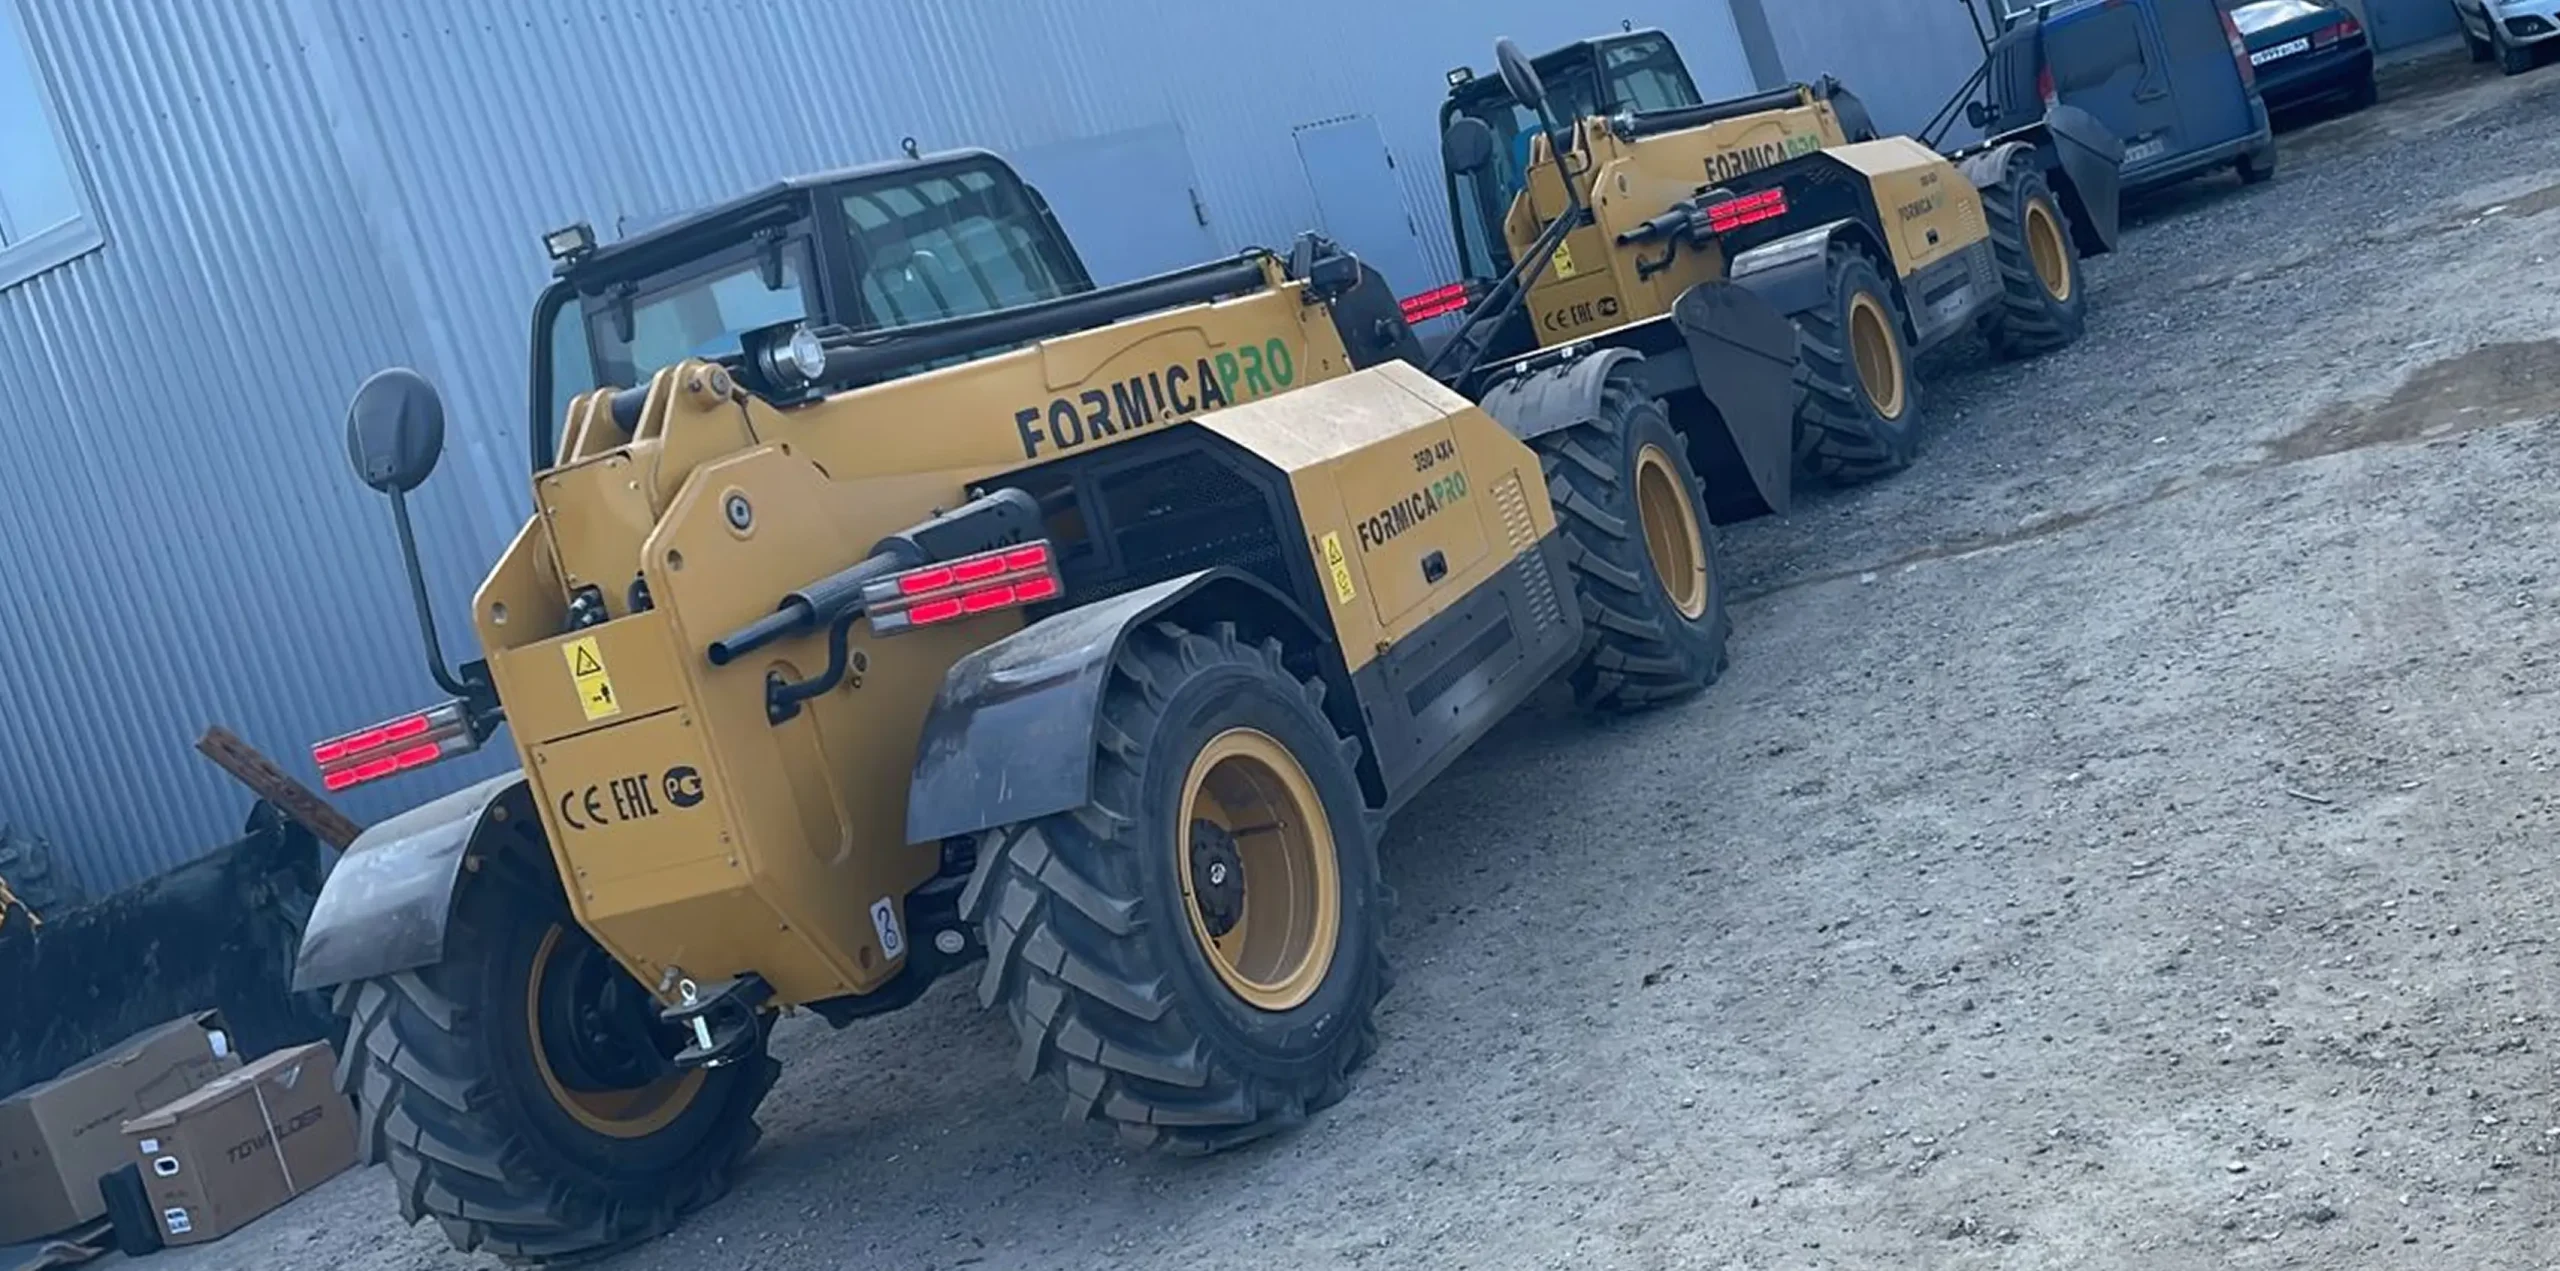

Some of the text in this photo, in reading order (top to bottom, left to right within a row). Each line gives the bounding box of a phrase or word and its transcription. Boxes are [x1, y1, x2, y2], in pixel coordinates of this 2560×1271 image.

[1015, 337, 1294, 459] FORMICAPRO
[1357, 470, 1467, 552] FORMICAPRO
[560, 784, 609, 830] CE
